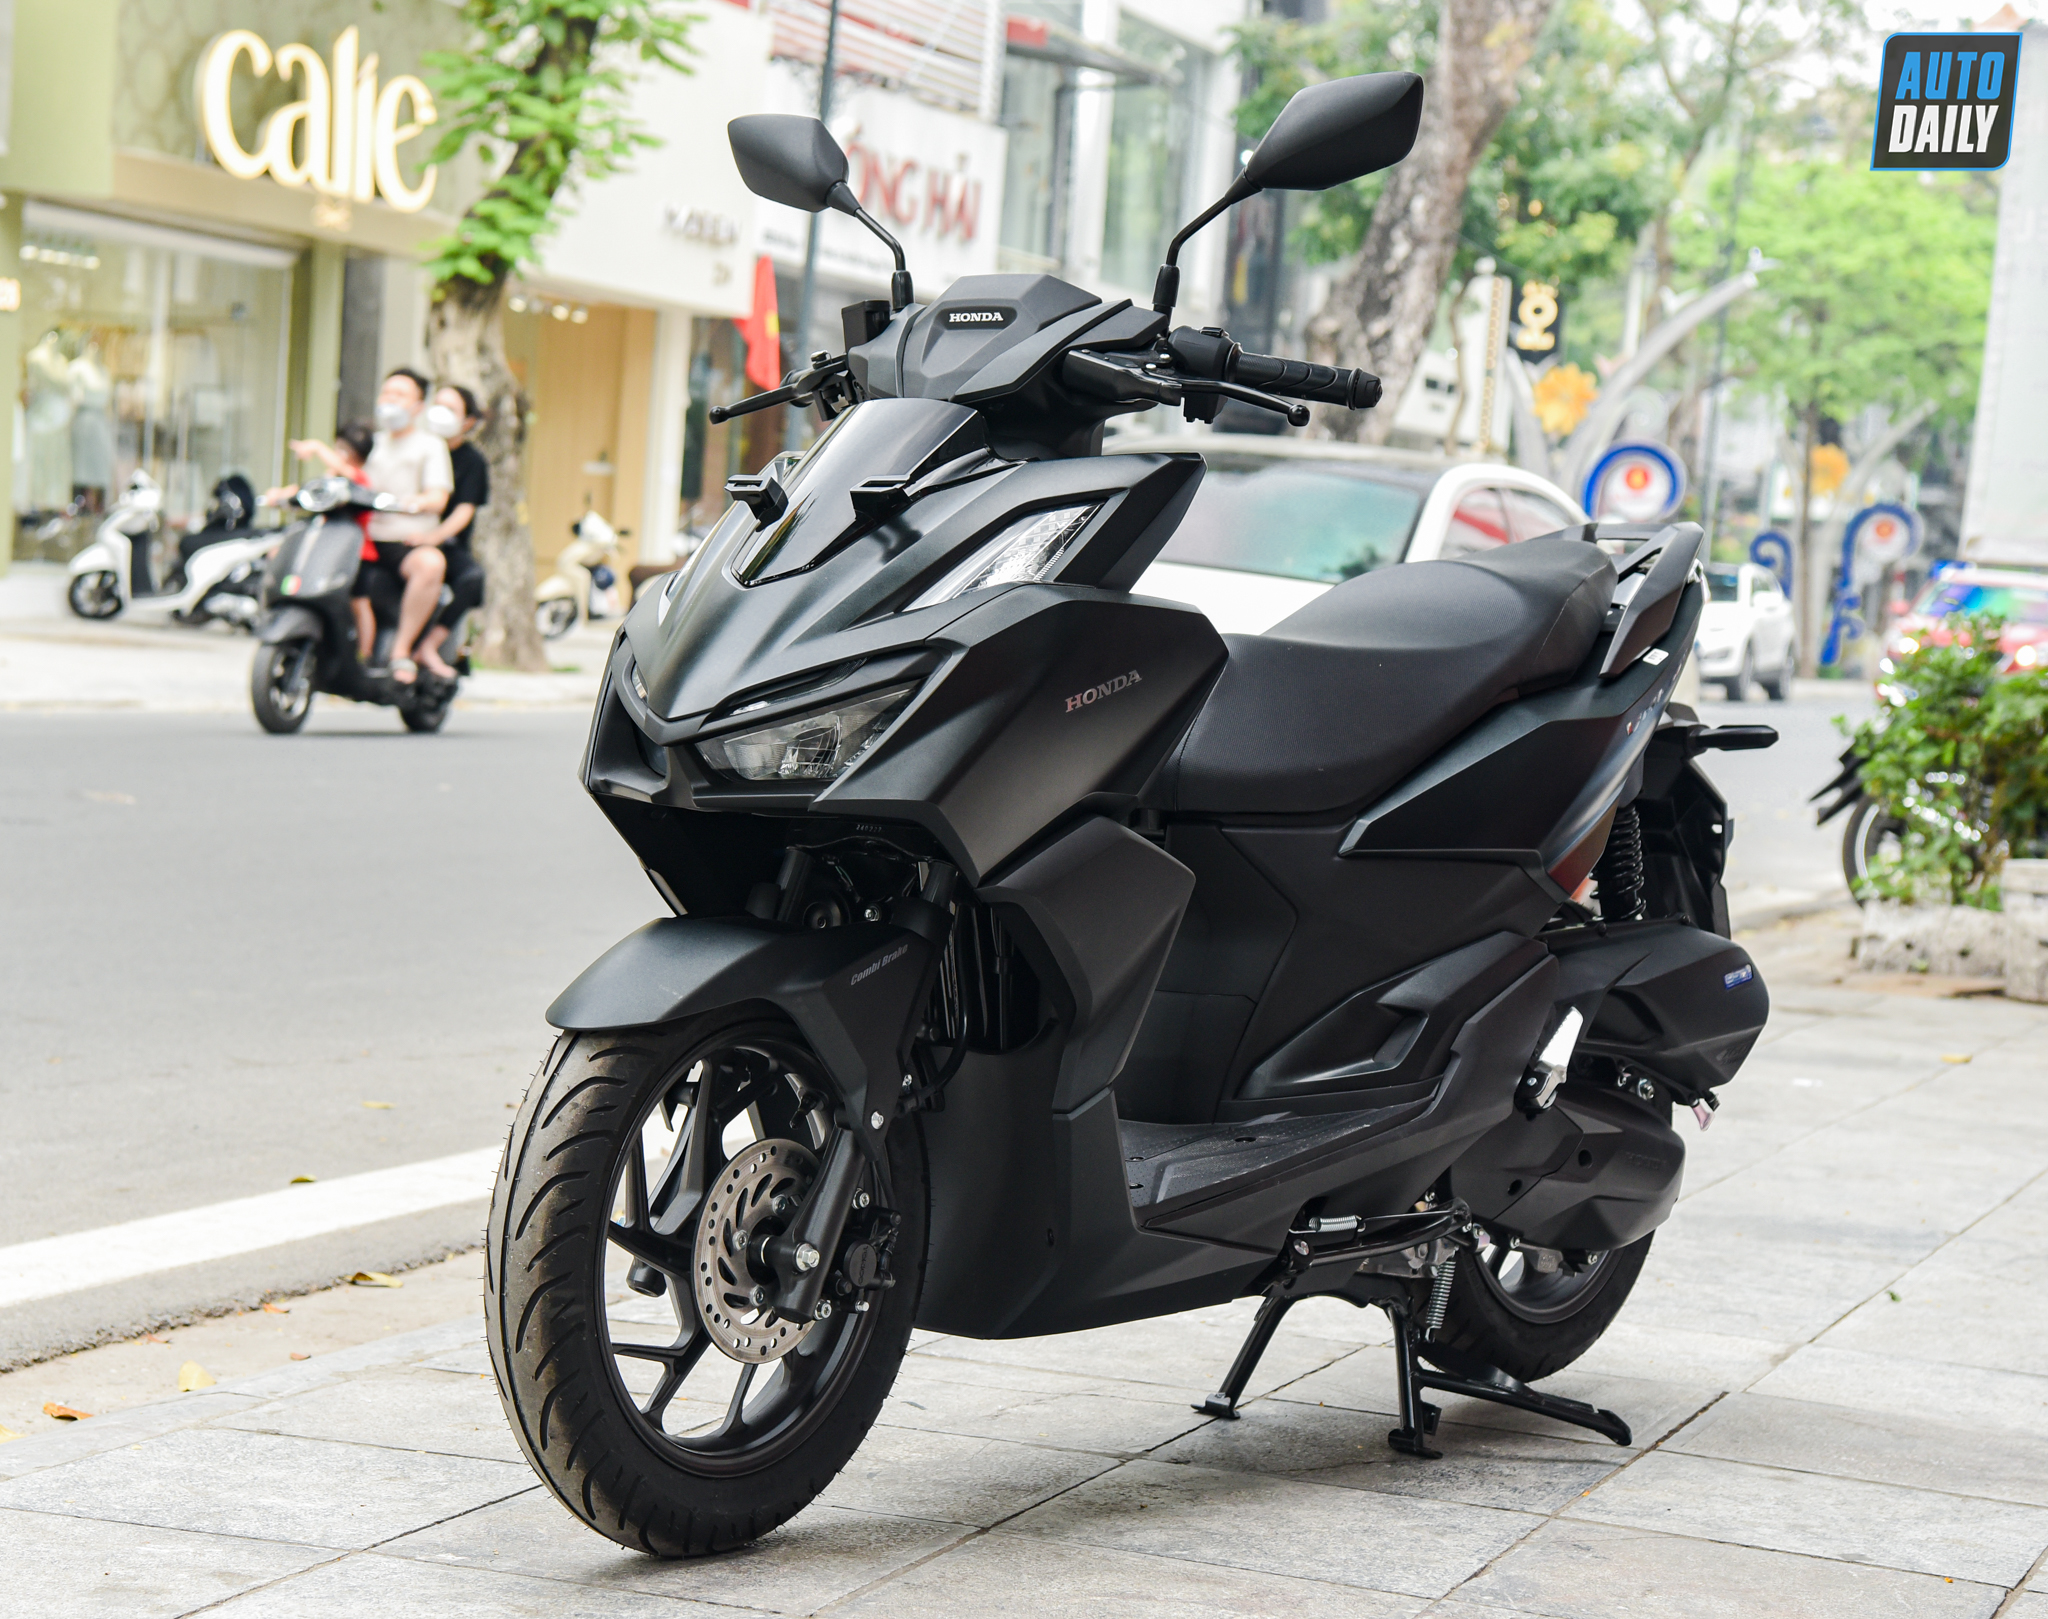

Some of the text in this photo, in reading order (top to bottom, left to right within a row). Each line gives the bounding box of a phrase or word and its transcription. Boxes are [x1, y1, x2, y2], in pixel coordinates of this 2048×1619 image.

[948, 311, 1004, 323] HONDA
[1064, 669, 1143, 713] HONDA
[850, 944, 909, 986] Combi Brake
